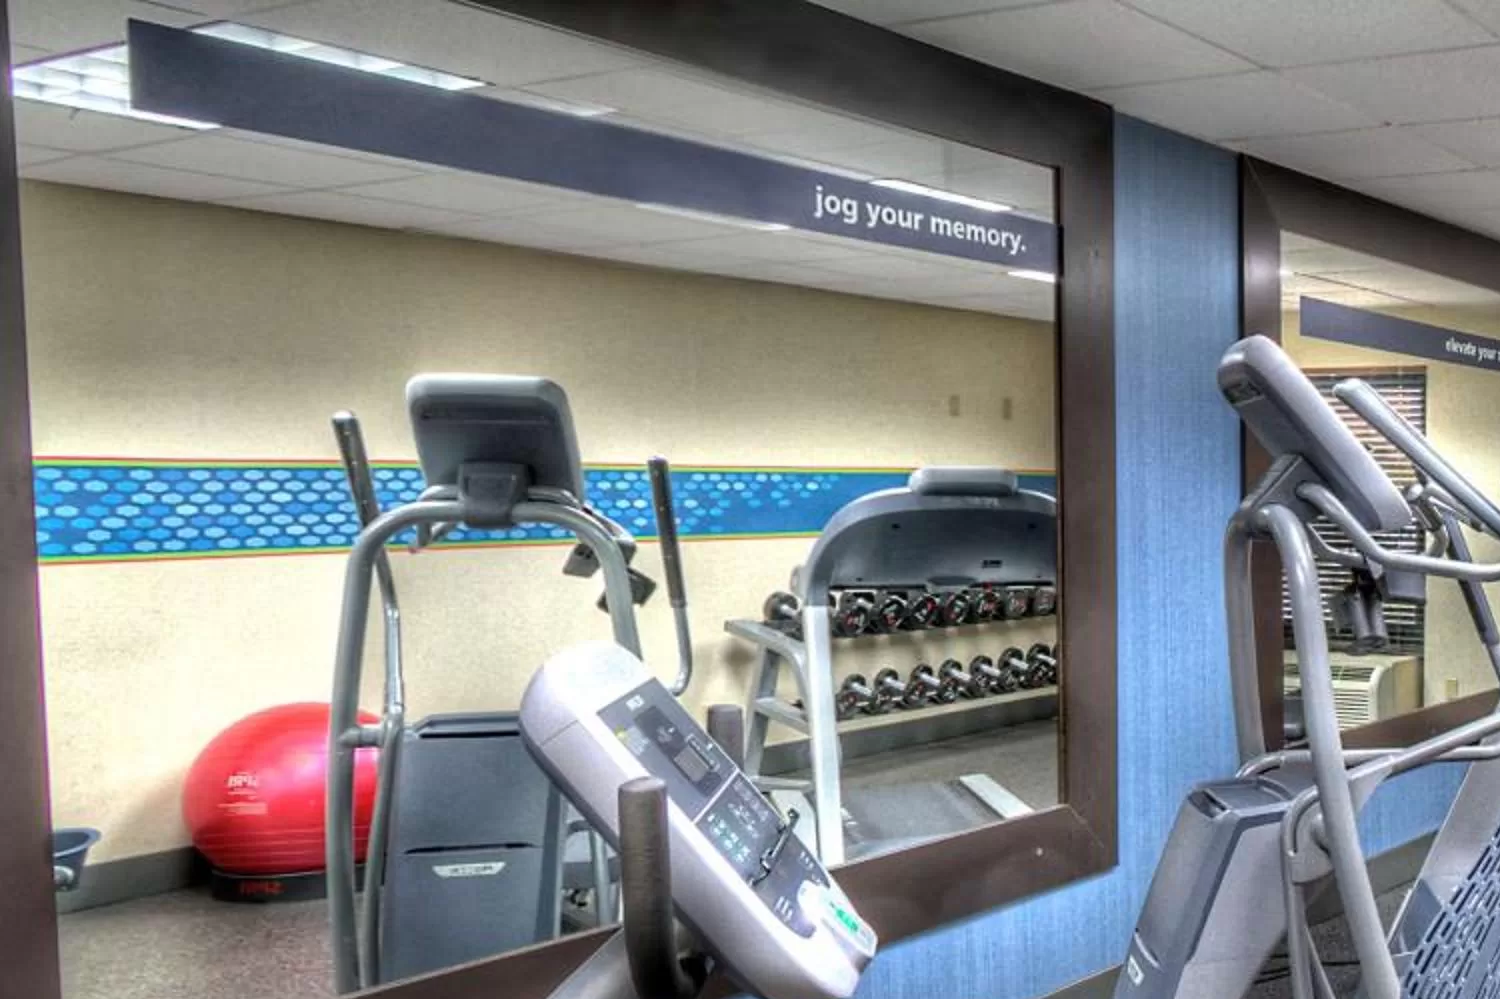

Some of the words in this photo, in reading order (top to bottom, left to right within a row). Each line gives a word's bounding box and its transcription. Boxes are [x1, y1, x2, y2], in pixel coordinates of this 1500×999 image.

[813, 185, 858, 224] jog
[866, 203, 924, 228] your
[930, 216, 1027, 255] memory.
[1478, 346, 1497, 362] your
